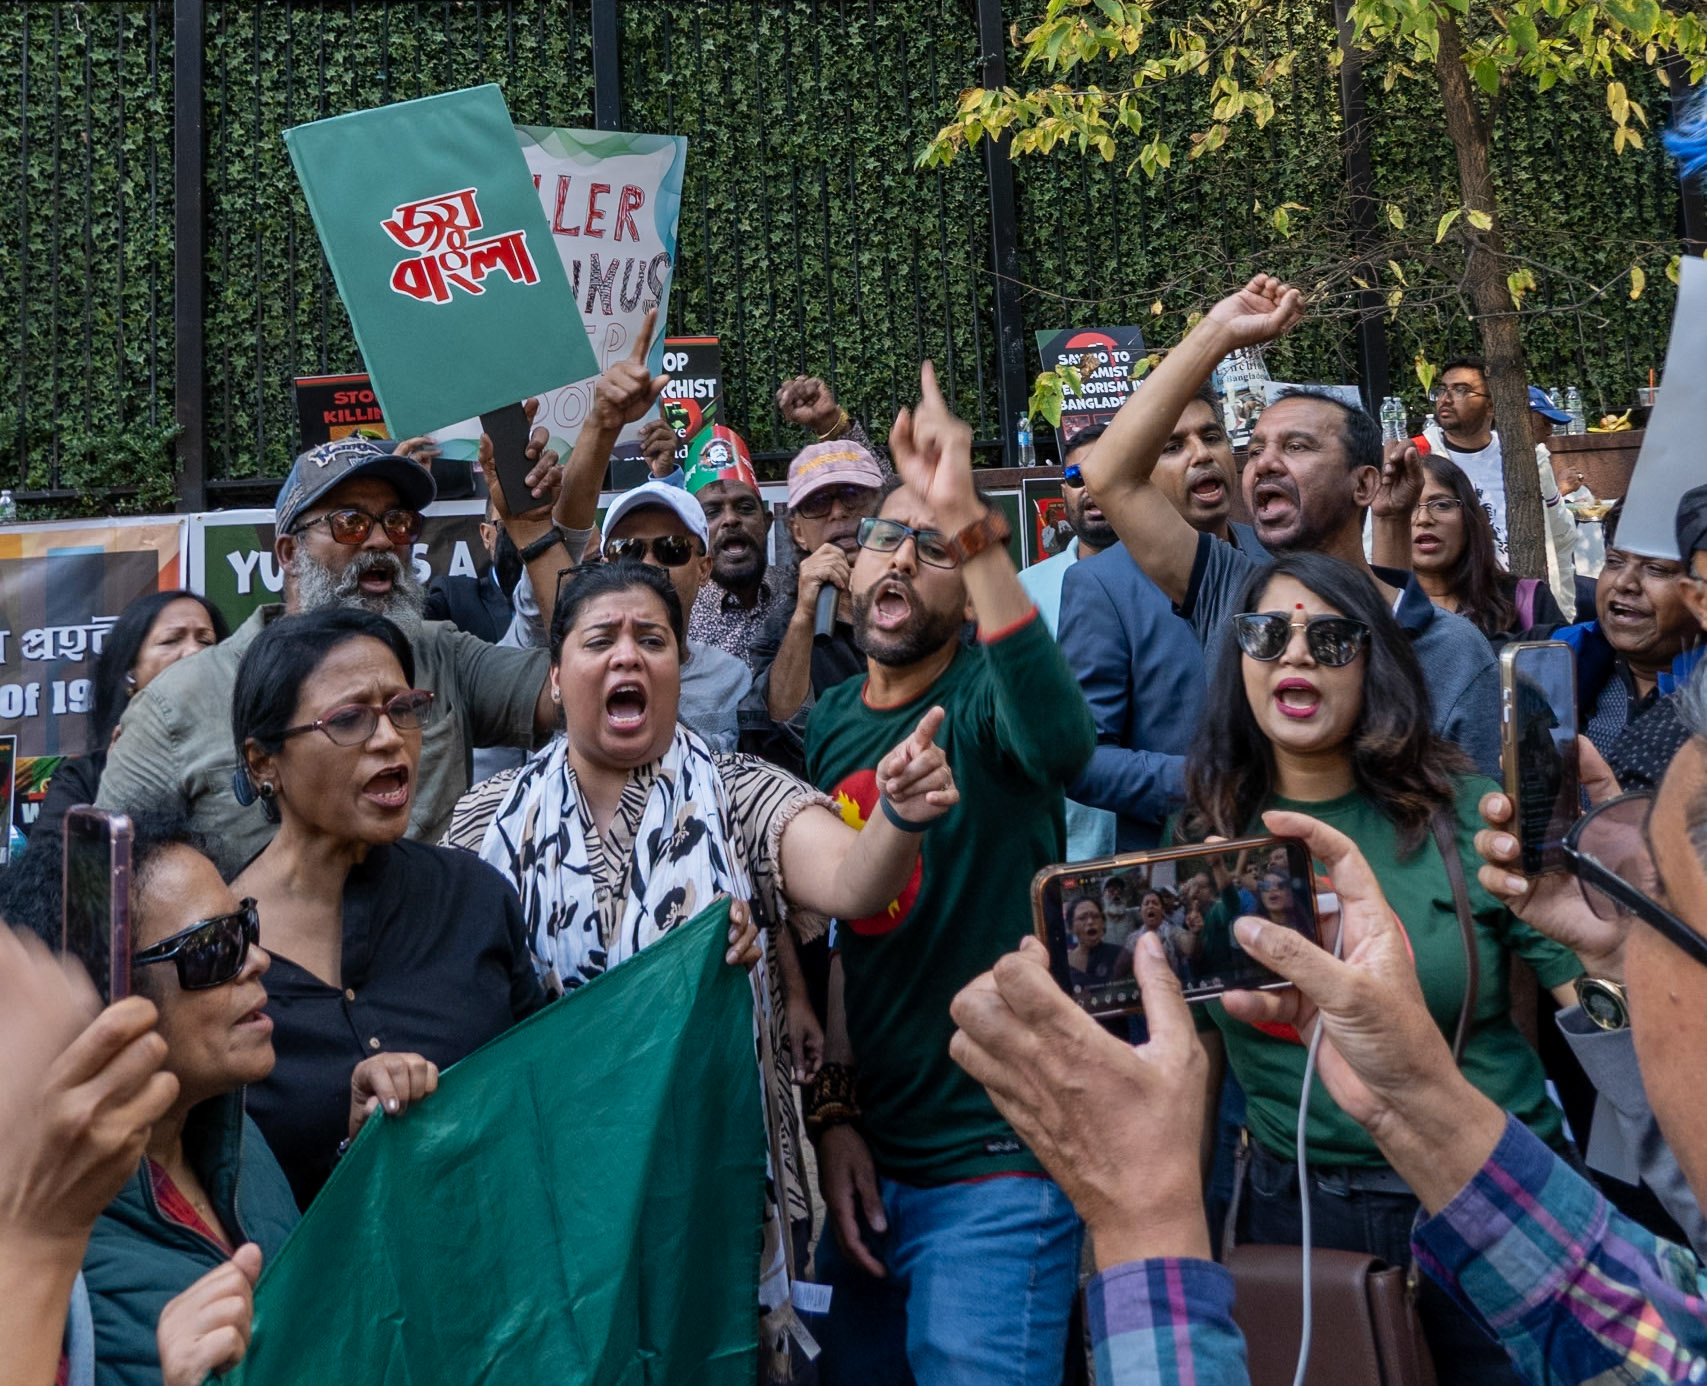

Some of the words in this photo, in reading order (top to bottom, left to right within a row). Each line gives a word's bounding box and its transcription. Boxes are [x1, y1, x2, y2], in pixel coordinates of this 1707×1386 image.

[533, 174, 646, 243] LER
[391, 230, 539, 303] বাংলা
[662, 352, 690, 372] OP
[1094, 351, 1109, 364] O
[1111, 350, 1131, 363] TO
[334, 390, 377, 405] STO
[1060, 396, 1129, 411] BANGLADE
[323, 406, 384, 424] KILLIN
[226, 549, 283, 594] YU
[411, 542, 432, 585] S
[448, 540, 478, 579] A
[52, 679, 93, 715] 19
